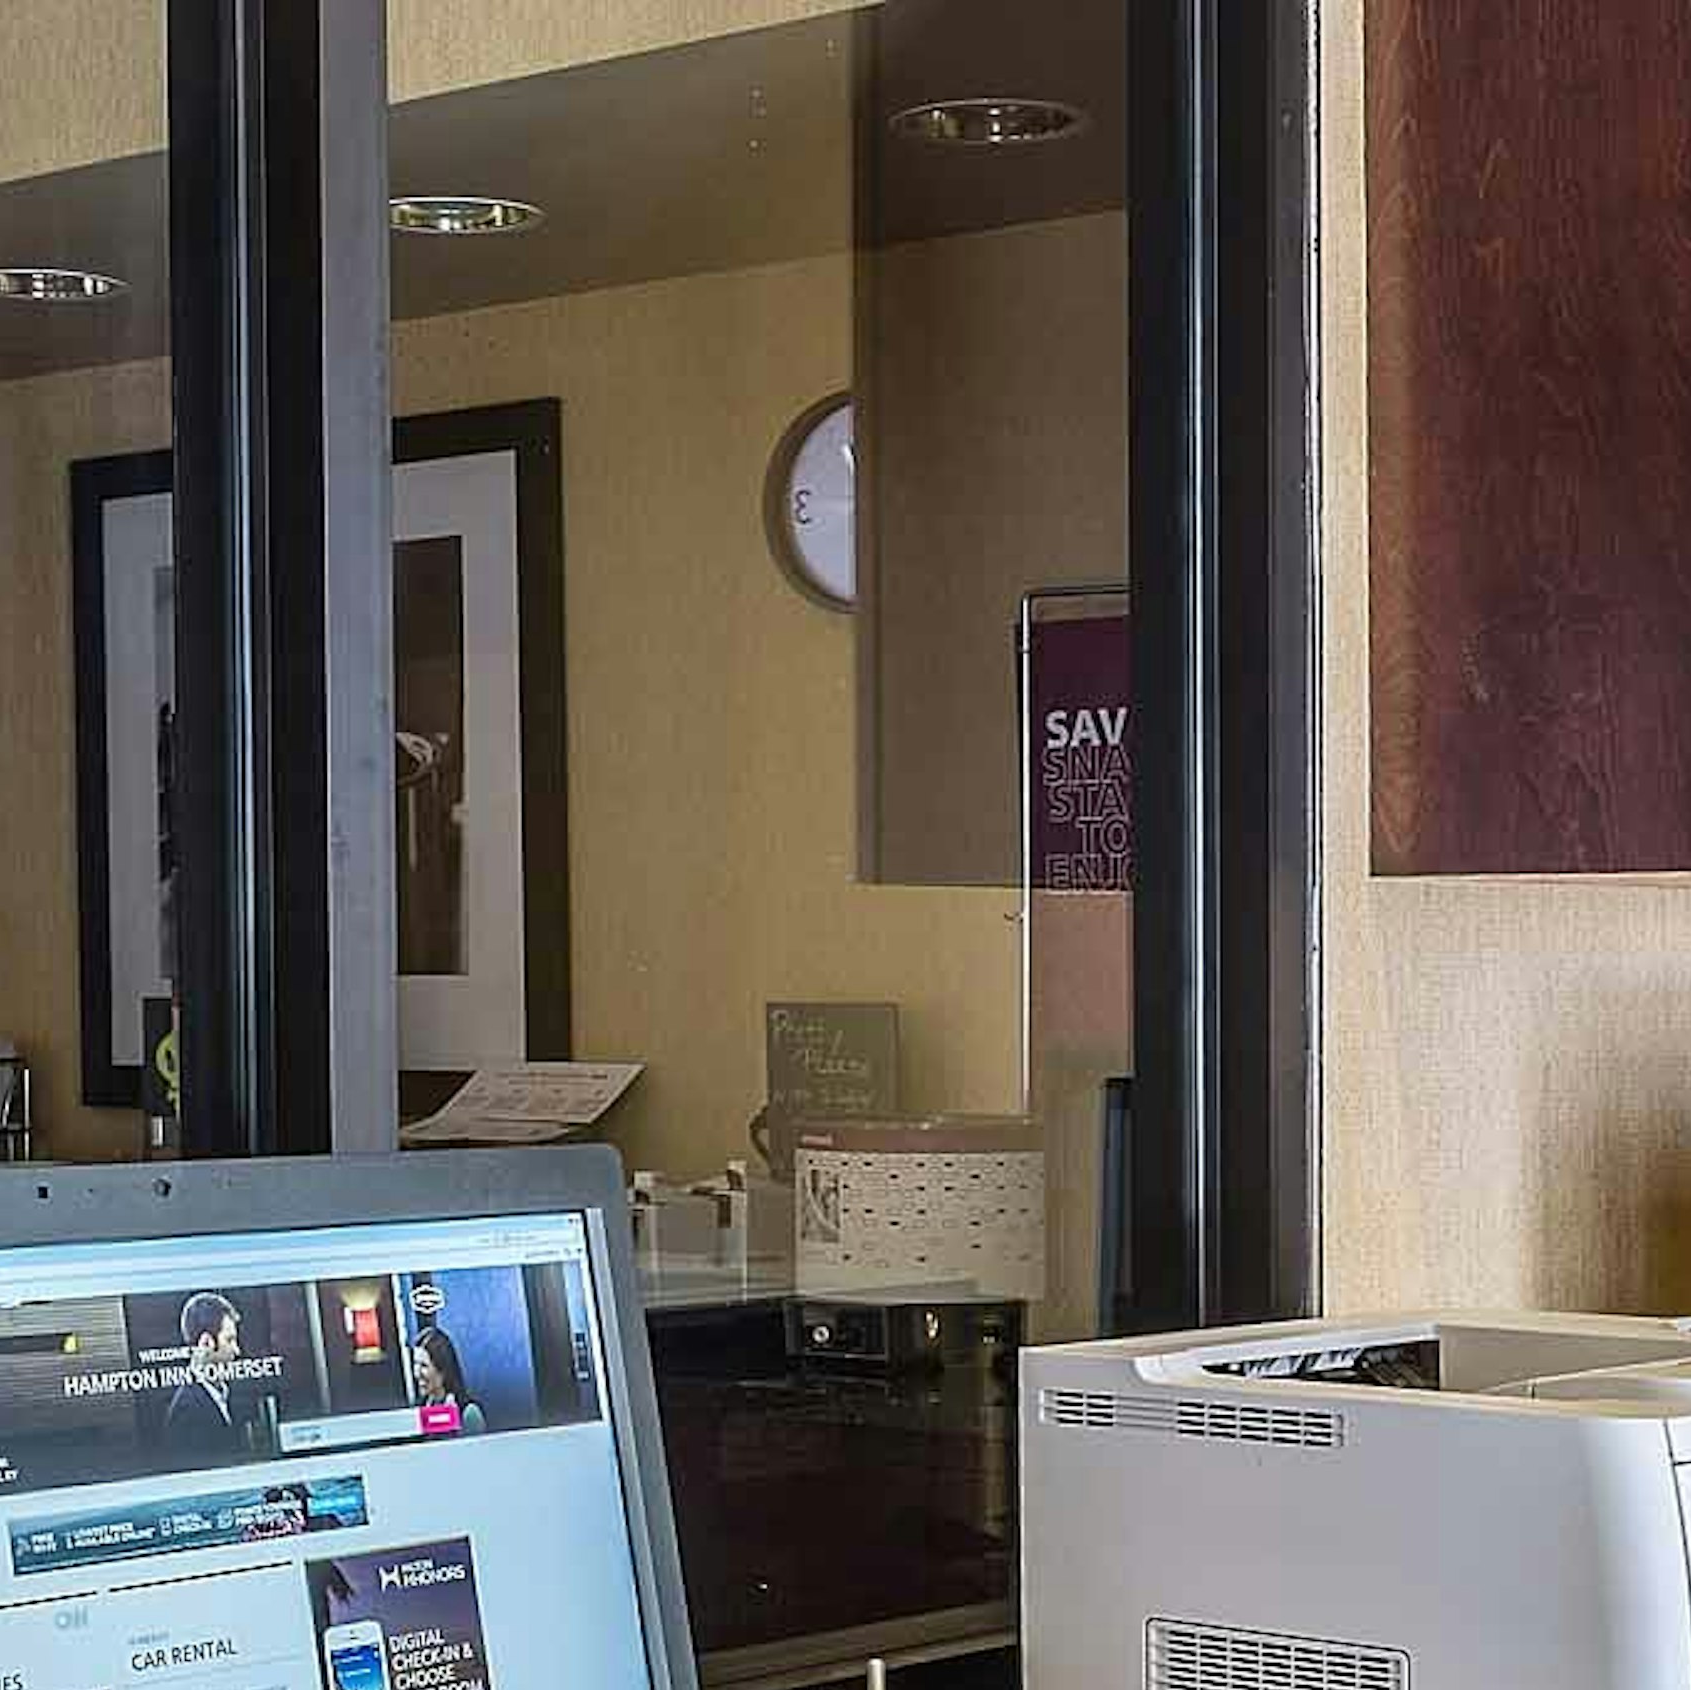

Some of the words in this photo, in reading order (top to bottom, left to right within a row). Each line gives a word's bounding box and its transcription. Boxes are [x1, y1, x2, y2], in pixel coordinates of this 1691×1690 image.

[1075, 815, 1128, 857] TO
[1044, 853, 1132, 893] ENJ
[64, 1368, 157, 1397] HAMPTON
[158, 1364, 193, 1387] INN
[193, 1356, 284, 1383] SOMERSET
[132, 1648, 168, 1672] CAR
[172, 1638, 239, 1665] RENTAL
[389, 1628, 445, 1650] DIGITAL
[392, 1645, 461, 1672] CHECK-IN
[463, 1643, 474, 1660] &
[395, 1664, 456, 1690] CHOOSE
